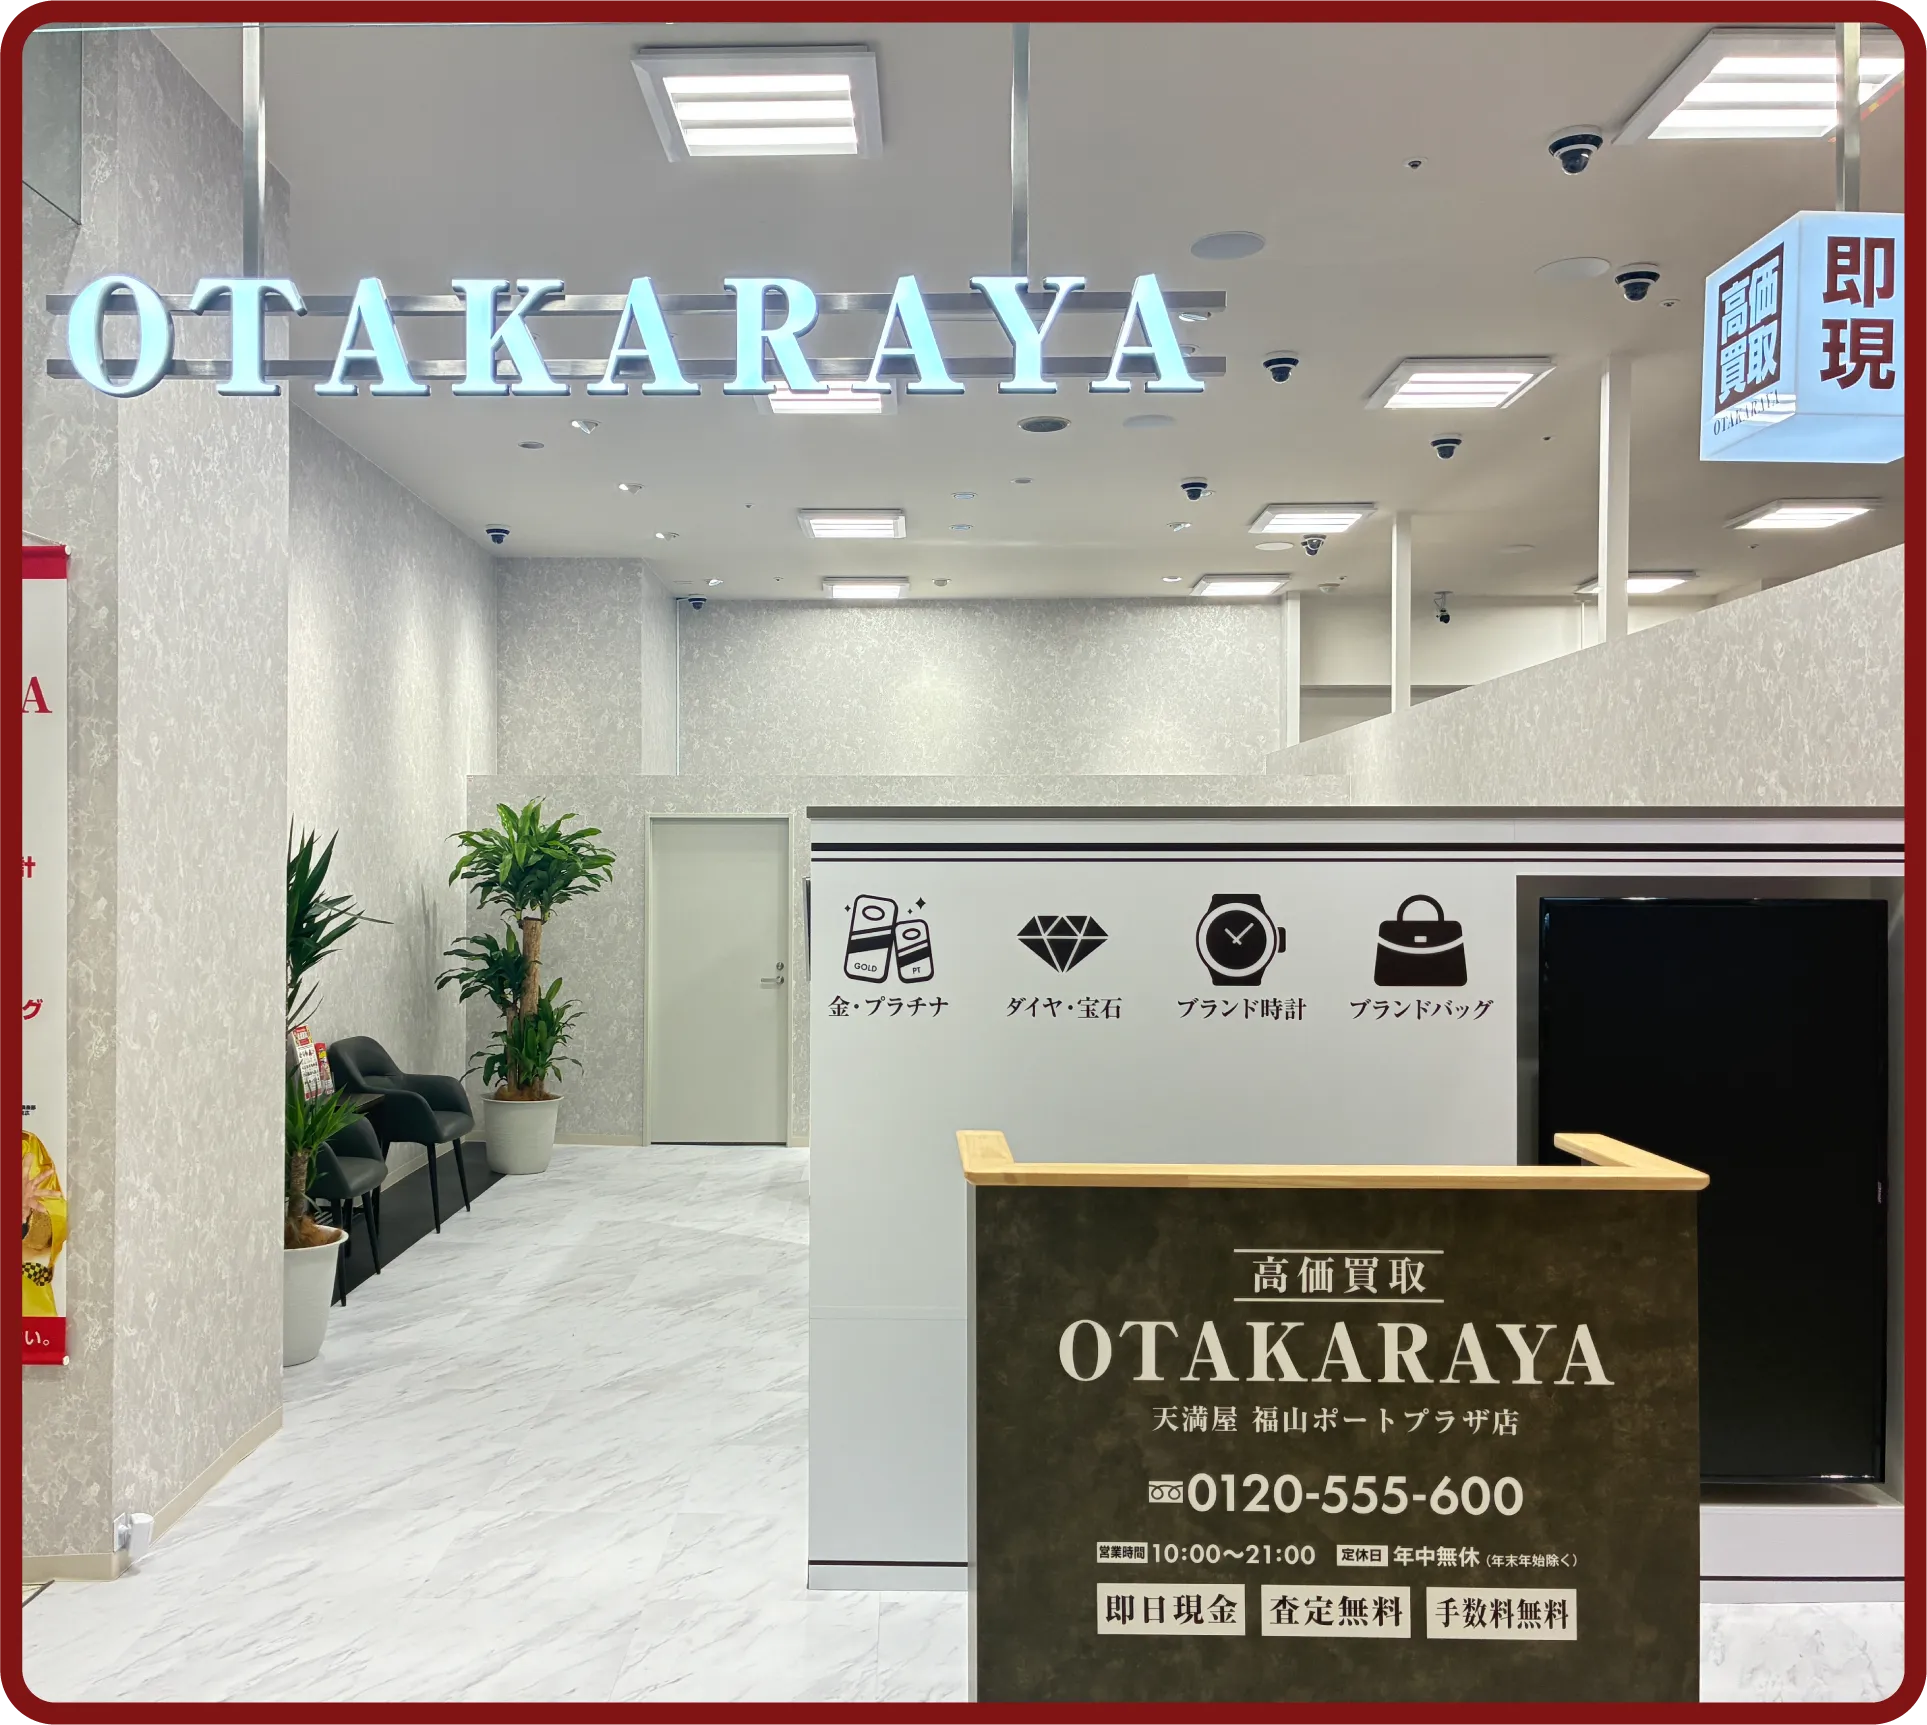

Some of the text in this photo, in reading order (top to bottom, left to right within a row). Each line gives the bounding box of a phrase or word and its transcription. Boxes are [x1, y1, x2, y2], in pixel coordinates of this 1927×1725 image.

[1822, 235, 1896, 309] 即
[1720, 255, 1780, 346] 高価
[67, 274, 1205, 398] OTAKARAYA
[1718, 319, 1778, 404] 買取
[1819, 317, 1896, 390] 現
[1713, 389, 1780, 436] OTAKARAYA
[853, 962, 878, 973] GOLD
[912, 966, 921, 975] PT
[828, 995, 949, 1019] 金・プラチナ
[1006, 995, 1122, 1020] ダイヤ・宝石
[1177, 997, 1307, 1021] ブランド時計
[1350, 997, 1494, 1022] ブランドバッグ
[1252, 1255, 1426, 1295] 高価買取
[1058, 1318, 1615, 1386] OTAKARAYA
[1152, 1405, 1519, 1436] 天満屋 福山ポートプラザ店
[1187, 1472, 1524, 1516] 0120-555-600
[1099, 1545, 1145, 1560] 営業時間
[1341, 1547, 1382, 1562] 定休日
[1393, 1545, 1481, 1568] 年中無休
[1105, 1592, 1238, 1625] 即日現金
[1269, 1594, 1403, 1627] 査定無料
[1434, 1597, 1569, 1630] 手数料無料
